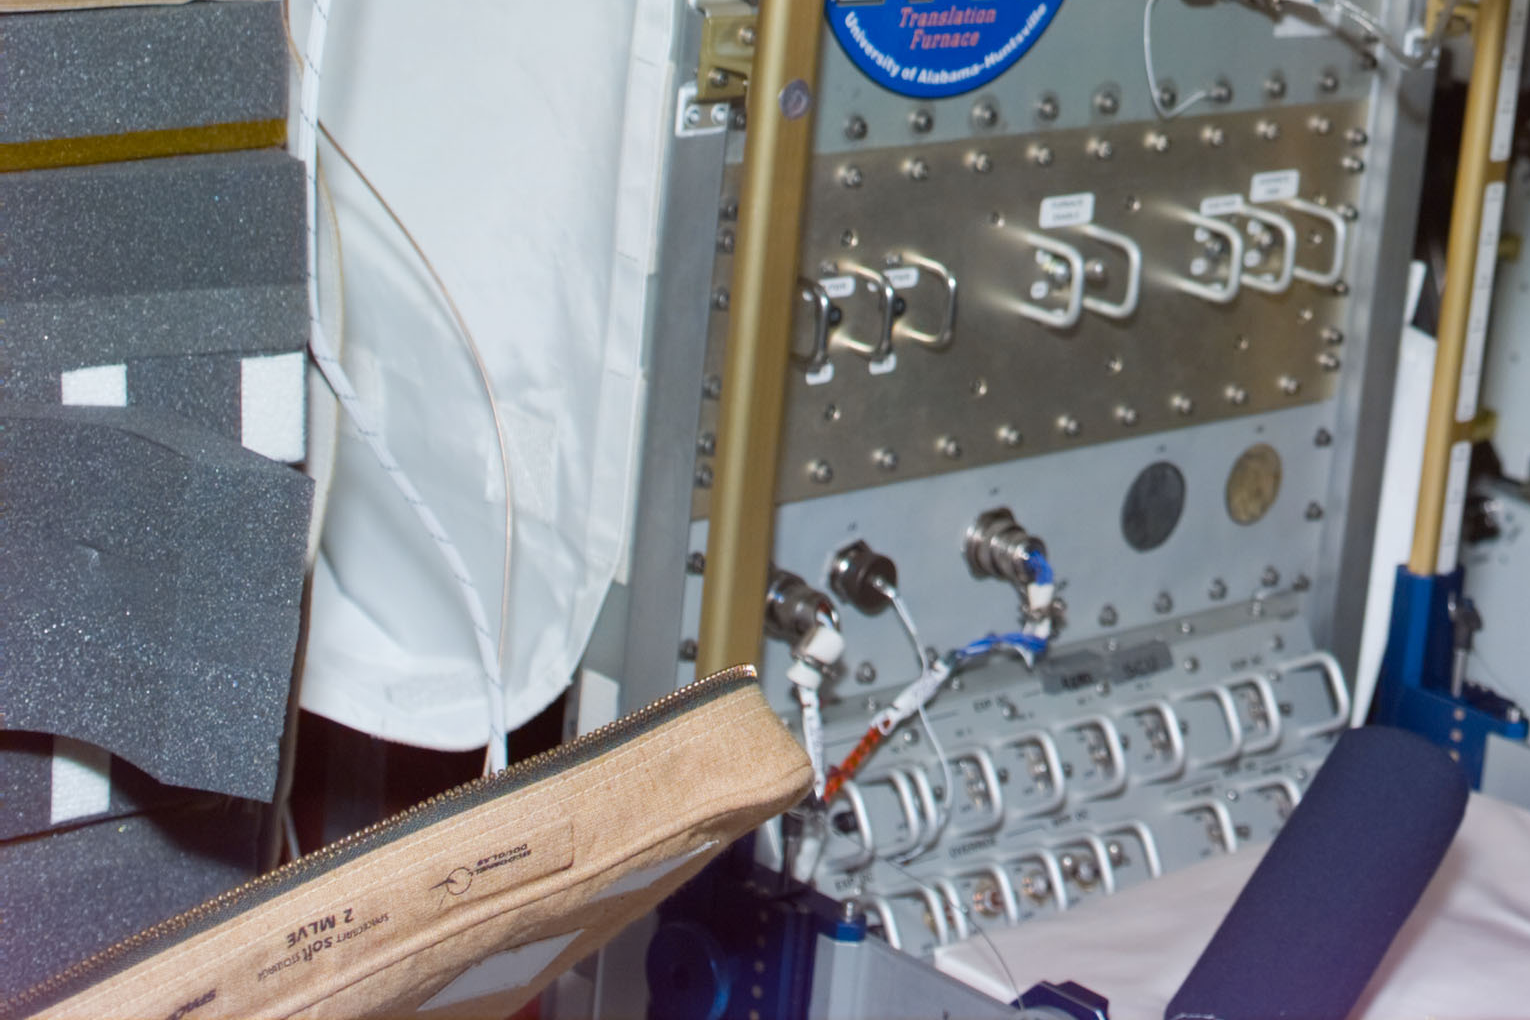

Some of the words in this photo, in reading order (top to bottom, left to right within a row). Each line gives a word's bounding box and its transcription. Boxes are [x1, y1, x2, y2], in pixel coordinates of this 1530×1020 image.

[899, 6, 997, 28] Translation
[845, 11, 900, 78] University
[901, 67, 918, 81] of
[917, 3, 1047, 84] Alabama-Huntsville
[910, 29, 980, 50] Furnace
[343, 907, 355, 924] 2
[286, 914, 336, 949] MLVE
